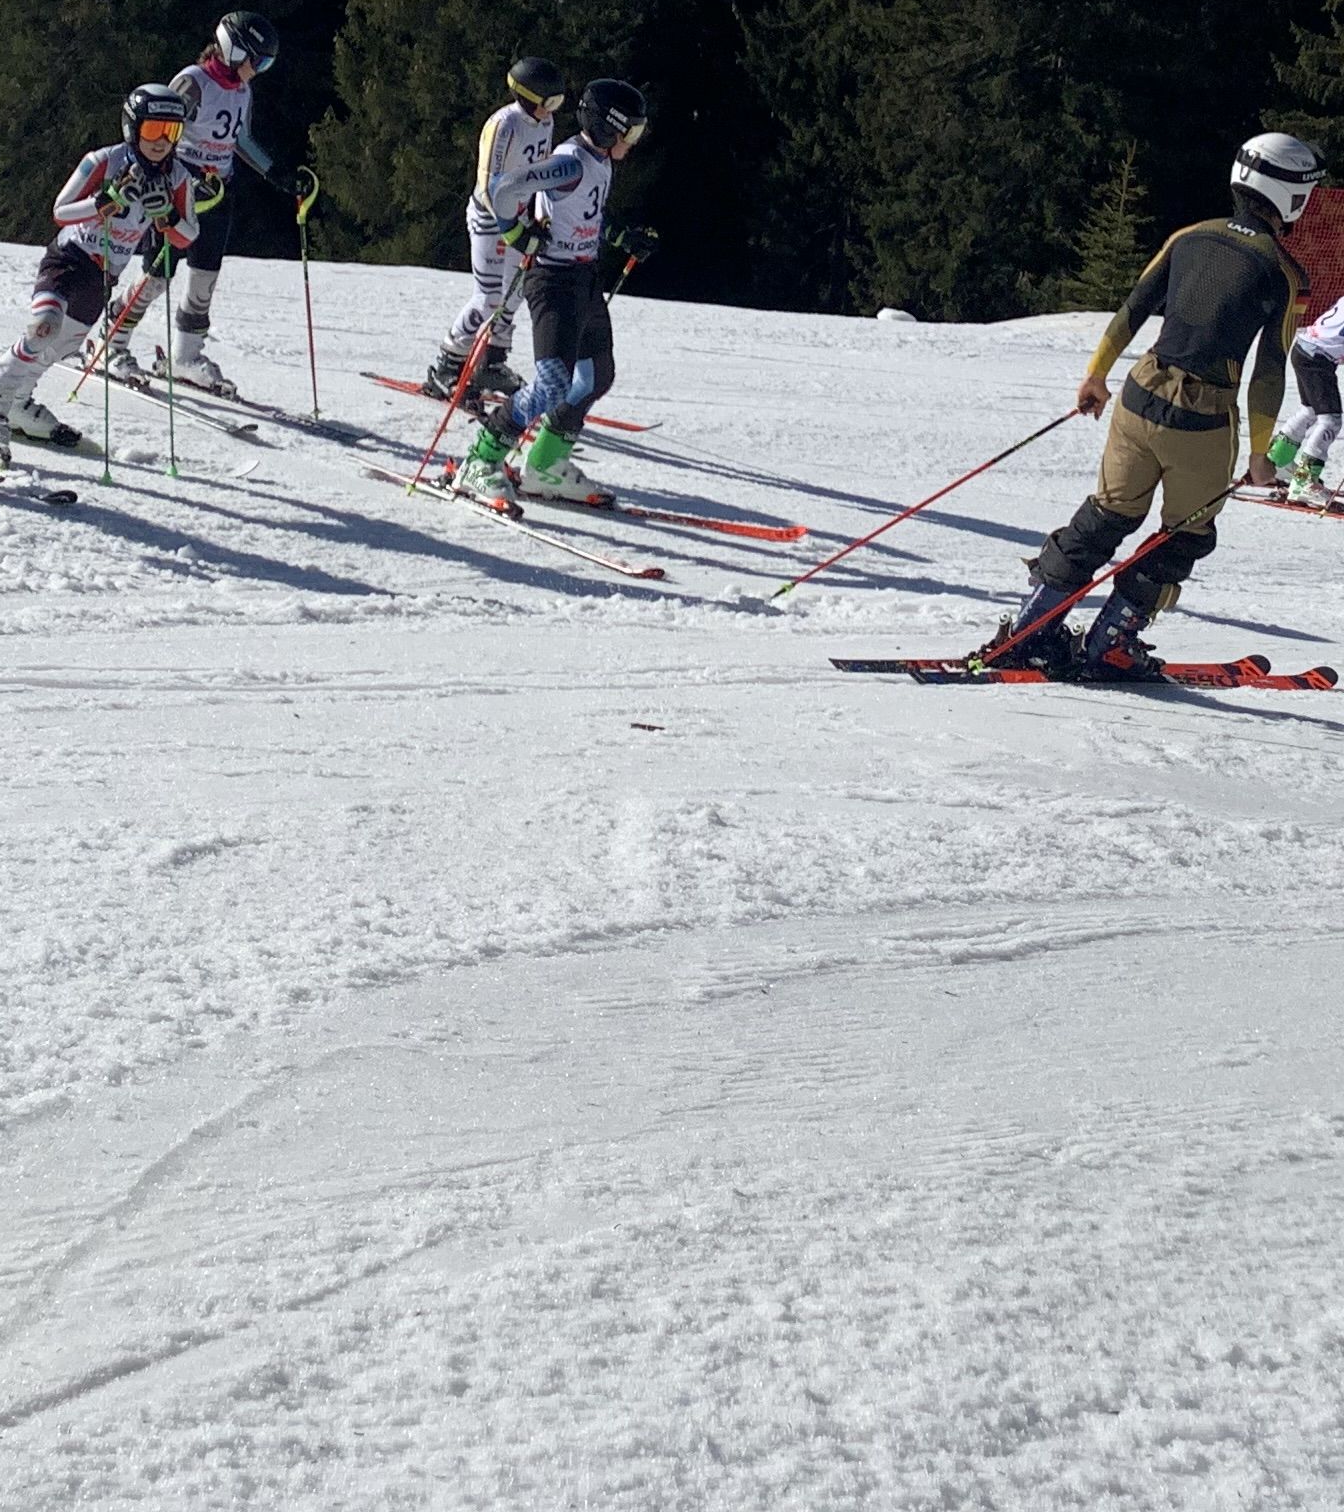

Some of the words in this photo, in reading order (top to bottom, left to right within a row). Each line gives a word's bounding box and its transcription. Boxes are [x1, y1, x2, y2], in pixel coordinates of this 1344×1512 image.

[525, 165, 569, 182] Audi
[1302, 169, 1327, 181] uvex
[557, 240, 575, 251] SKI
